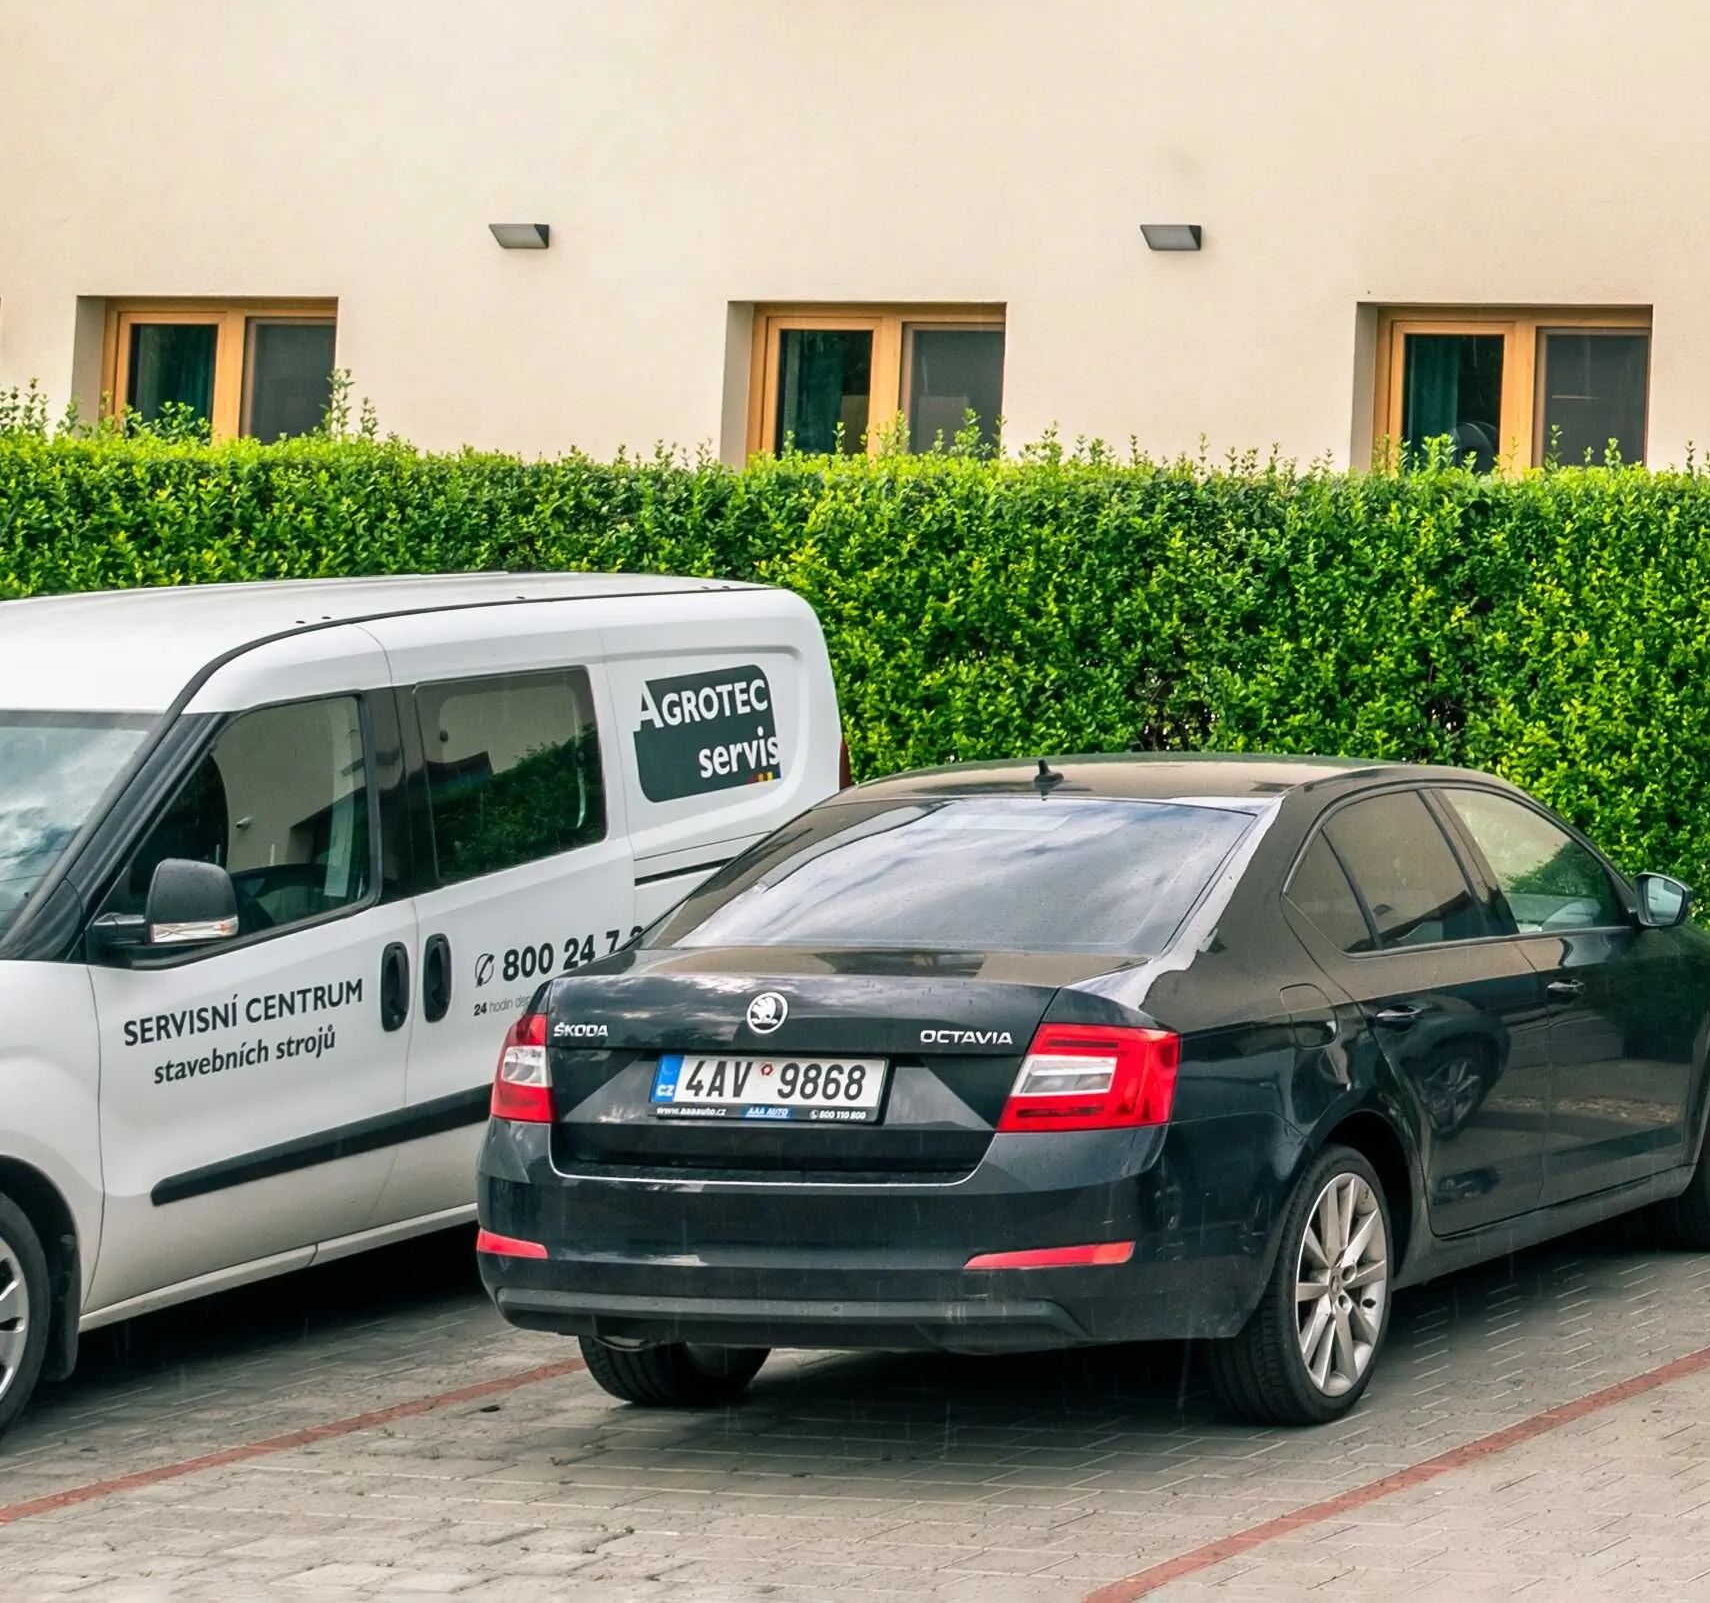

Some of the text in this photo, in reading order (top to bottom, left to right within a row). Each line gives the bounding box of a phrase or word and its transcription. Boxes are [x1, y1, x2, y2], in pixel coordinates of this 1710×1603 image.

[633, 678, 769, 732] AGROTEC
[698, 725, 781, 779] servis
[502, 942, 555, 982] 800
[562, 933, 596, 971] 24
[123, 978, 364, 1047] SERVISNÍ CENTRUM
[473, 1002, 488, 1017] 24
[553, 1021, 609, 1038] ŠKODA
[153, 1023, 336, 1085] stavebních strojů
[920, 1029, 1013, 1045] OCTAVIA
[656, 1060, 867, 1101] CZ 4AV 9868
